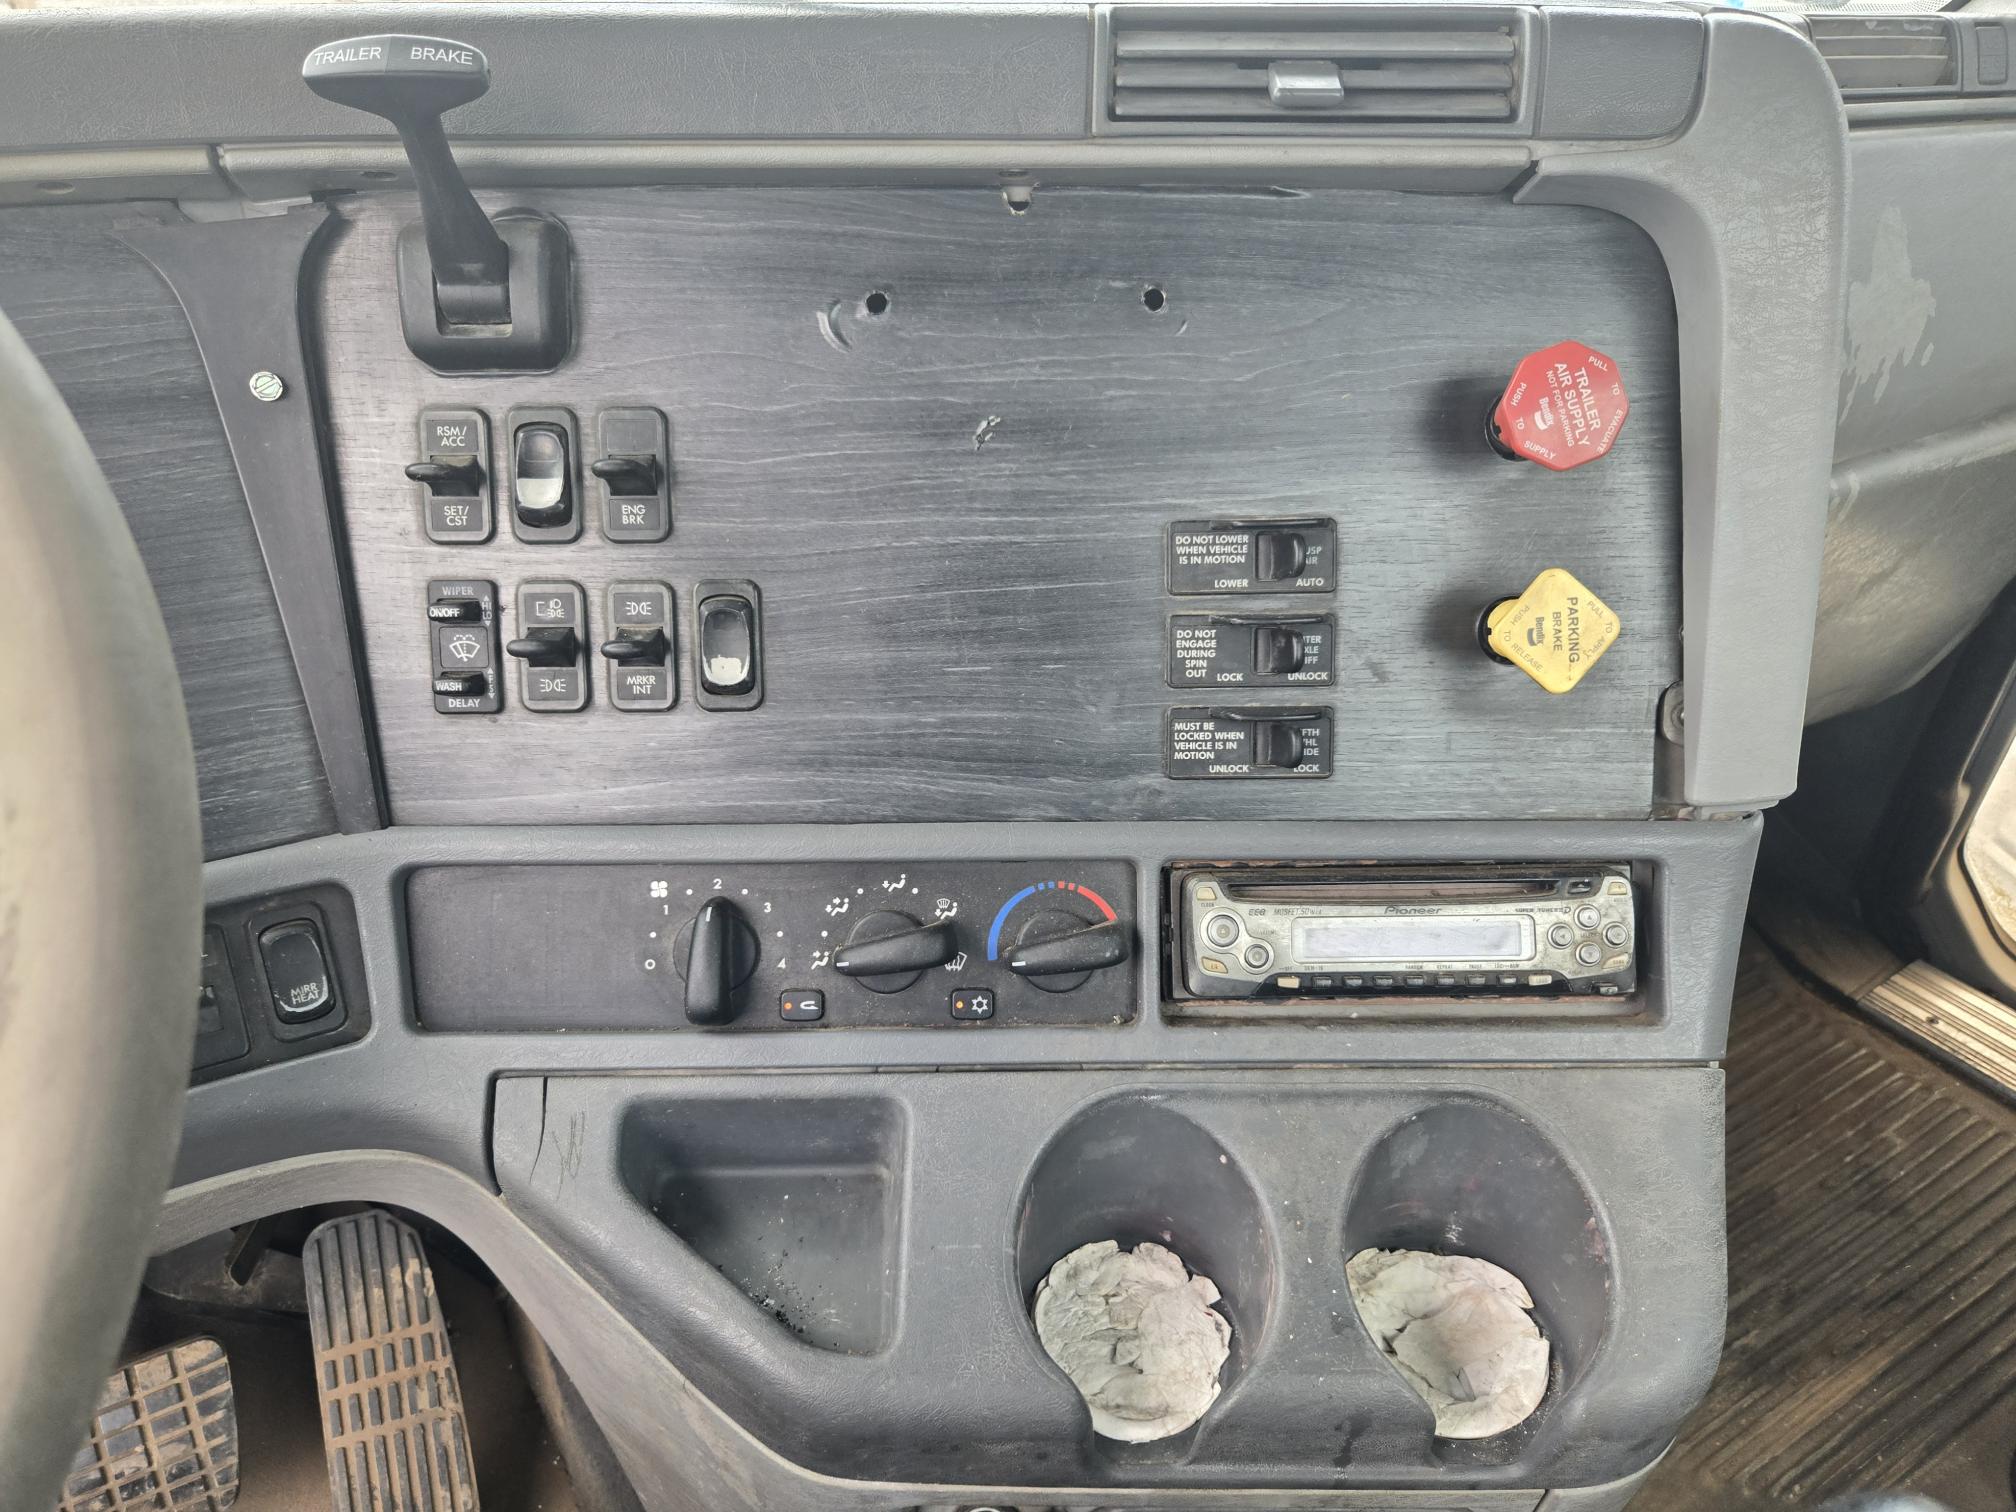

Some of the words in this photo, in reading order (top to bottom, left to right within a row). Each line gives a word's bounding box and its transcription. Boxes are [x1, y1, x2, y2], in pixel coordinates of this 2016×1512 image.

[314, 47, 382, 65] TRAILER
[410, 47, 473, 65] BRAKE
[1588, 356, 1608, 371] PULL
[1511, 382, 1527, 406] PUSH
[1611, 383, 1620, 395] TO
[1574, 367, 1601, 431] TRAILER
[1546, 370, 1558, 388] NOT
[1553, 390, 1563, 407] FOR
[1559, 409, 1575, 447] PARKING
[1554, 363, 1572, 387] AIR
[1565, 390, 1590, 446] SUPPLY
[1515, 417, 1524, 430] TO
[437, 426, 467, 436] RSM/
[1596, 409, 1623, 453] EVACUATE
[441, 436, 466, 446] ACC
[1524, 441, 1556, 459] SUPPLY
[444, 506, 468, 516] SET/
[622, 505, 645, 514] ENG
[446, 516, 468, 526] CST
[622, 515, 645, 524] BRK
[1176, 536, 1190, 544] DO
[1193, 536, 1213, 544] NOT
[1216, 535, 1249, 543] LOWER
[1176, 546, 1206, 555] WHEN
[1209, 545, 1248, 554] VEHICLE
[1179, 556, 1188, 564] IS
[1190, 556, 1202, 564] IN
[1204, 555, 1245, 564] MOTION
[1214, 579, 1248, 588] LOWER
[1295, 578, 1324, 587] AUTO
[442, 586, 474, 596] WIPER
[481, 602, 492, 610] HI
[482, 611, 492, 620] LO
[1587, 601, 1604, 618] PULL
[1605, 622, 1612, 633] TO
[1176, 630, 1192, 638] DO
[1195, 630, 1216, 638] NOT
[1552, 612, 1562, 651] BRAKE
[1567, 597, 1580, 663] PARKING
[1176, 640, 1217, 648] ENGAGE
[1176, 650, 1216, 658] DURING
[1304, 645, 1320, 654] XLE
[1503, 630, 1511, 641] TO
[1511, 643, 1543, 672] RELEASE
[1185, 660, 1207, 668] SPIN
[1304, 656, 1319, 664] IFF
[1186, 669, 1207, 678] OUT
[1216, 673, 1244, 681] LOCK
[1287, 672, 1328, 680] UNLOCK
[627, 676, 656, 685] MRKR
[434, 681, 462, 691] WASH
[633, 685, 651, 694] INT
[448, 698, 480, 708] DELAY
[1174, 722, 1201, 730] MUST
[1203, 722, 1215, 730] BE
[1174, 732, 1211, 740] LOCKED
[1214, 732, 1244, 740] WHEN
[1174, 741, 1212, 750] VEHICLE
[1215, 741, 1223, 749] IS
[1226, 741, 1237, 749] IN
[1303, 738, 1318, 746] HL
[1174, 751, 1215, 760] MOTION
[1209, 764, 1249, 773] UNLOCK
[713, 878, 722, 889] 2
[663, 904, 669, 916] 1
[763, 902, 772, 913] 3
[1384, 905, 1444, 915] Pioneer
[290, 983, 318, 998] MIRR
[292, 990, 320, 1004] HEAT
